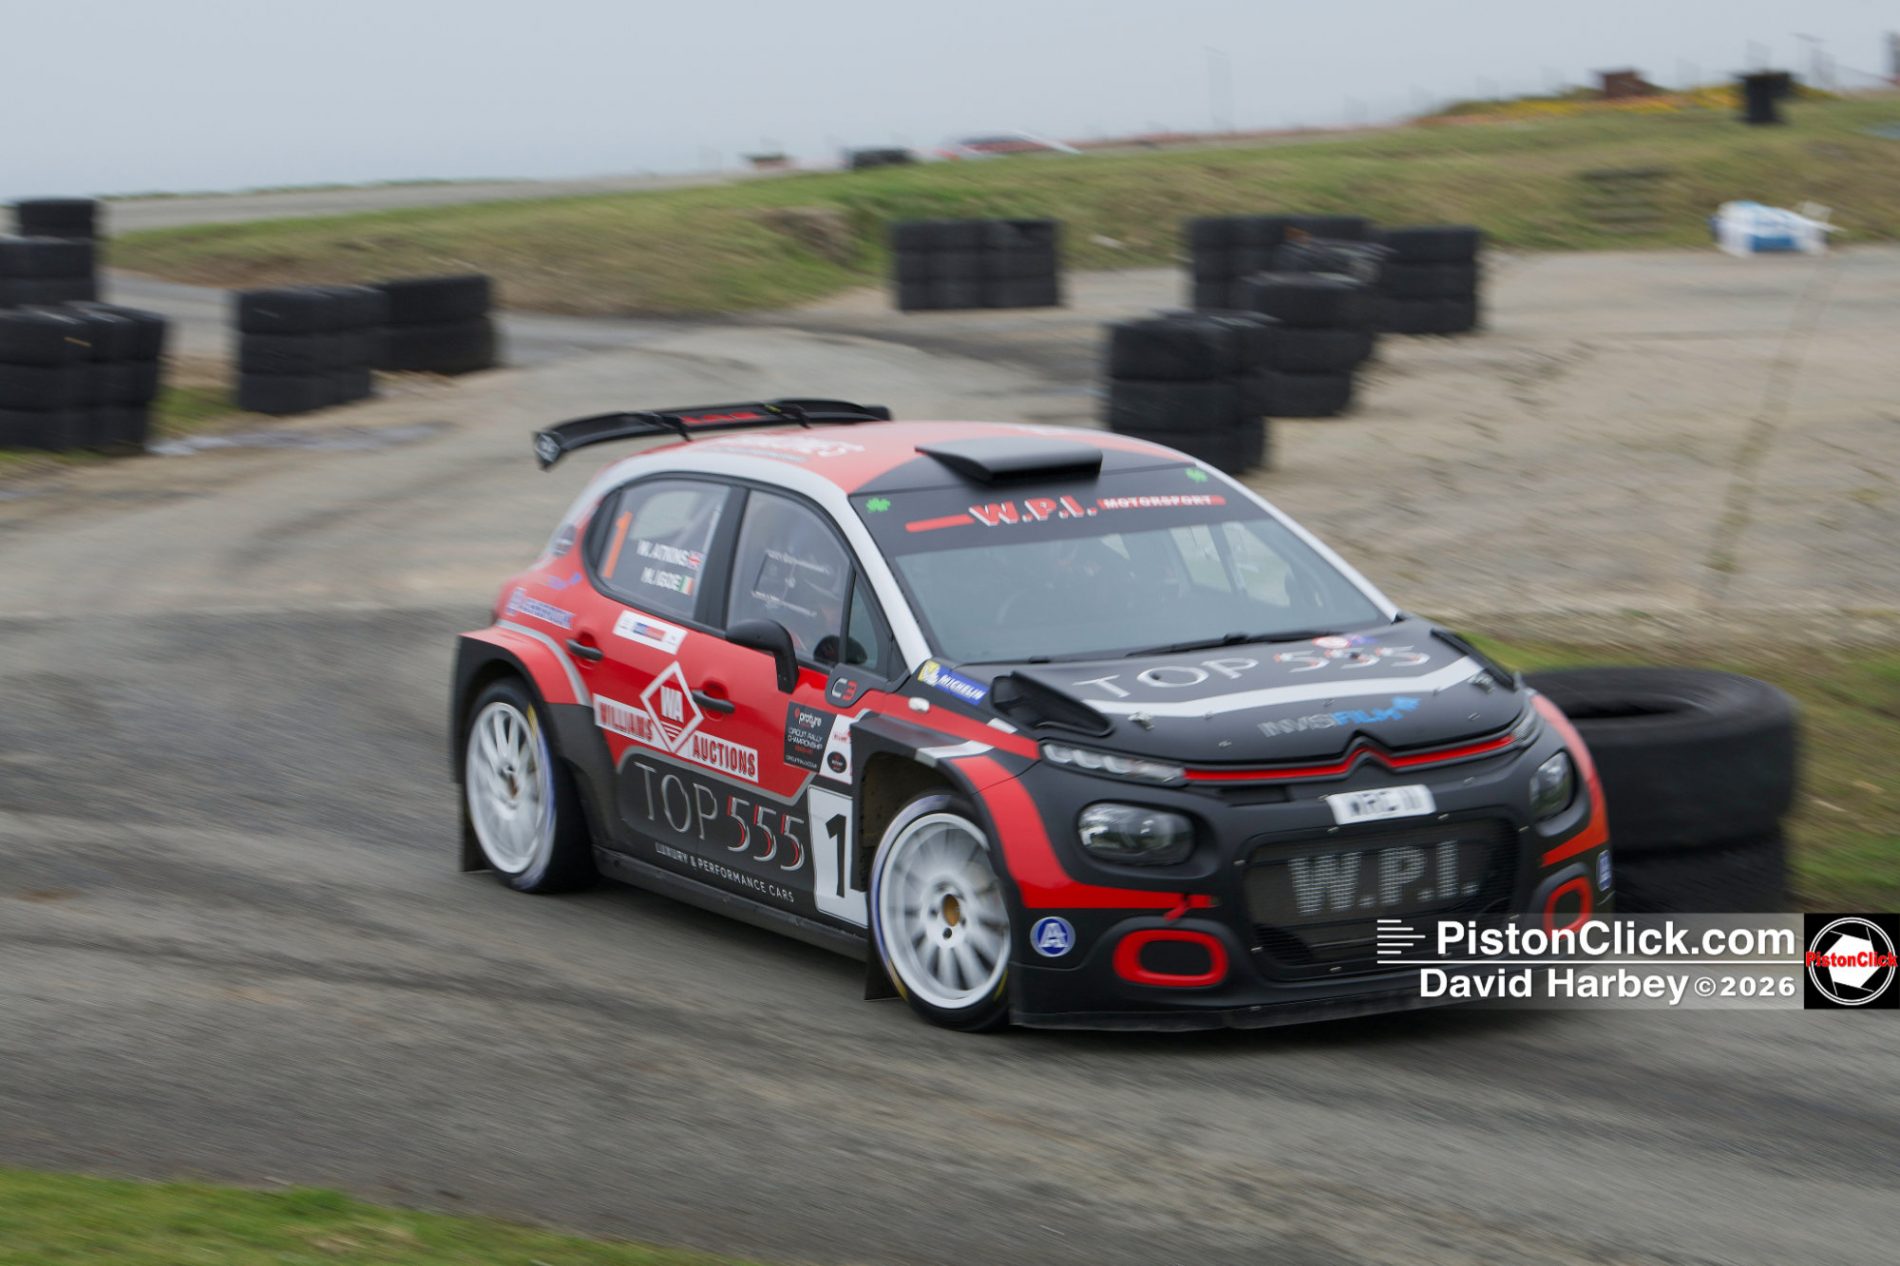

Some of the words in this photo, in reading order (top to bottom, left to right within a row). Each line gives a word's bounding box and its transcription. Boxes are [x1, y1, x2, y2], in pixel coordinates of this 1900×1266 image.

[969, 495, 1098, 526] W.P.I.
[1103, 494, 1212, 510] MOTORSPORT
[831, 677, 858, 701] C3
[939, 673, 987, 701] MICHELIN
[1072, 657, 1259, 698] TOP
[1273, 645, 1431, 674] 555
[693, 734, 756, 777] AUCTIONS
[634, 761, 719, 840] TOP
[727, 795, 805, 872] 555
[825, 813, 847, 898] 1
[1287, 840, 1480, 914] W.P.I.
[698, 858, 766, 893] PERFORMANCE
[769, 885, 795, 903] CARS
